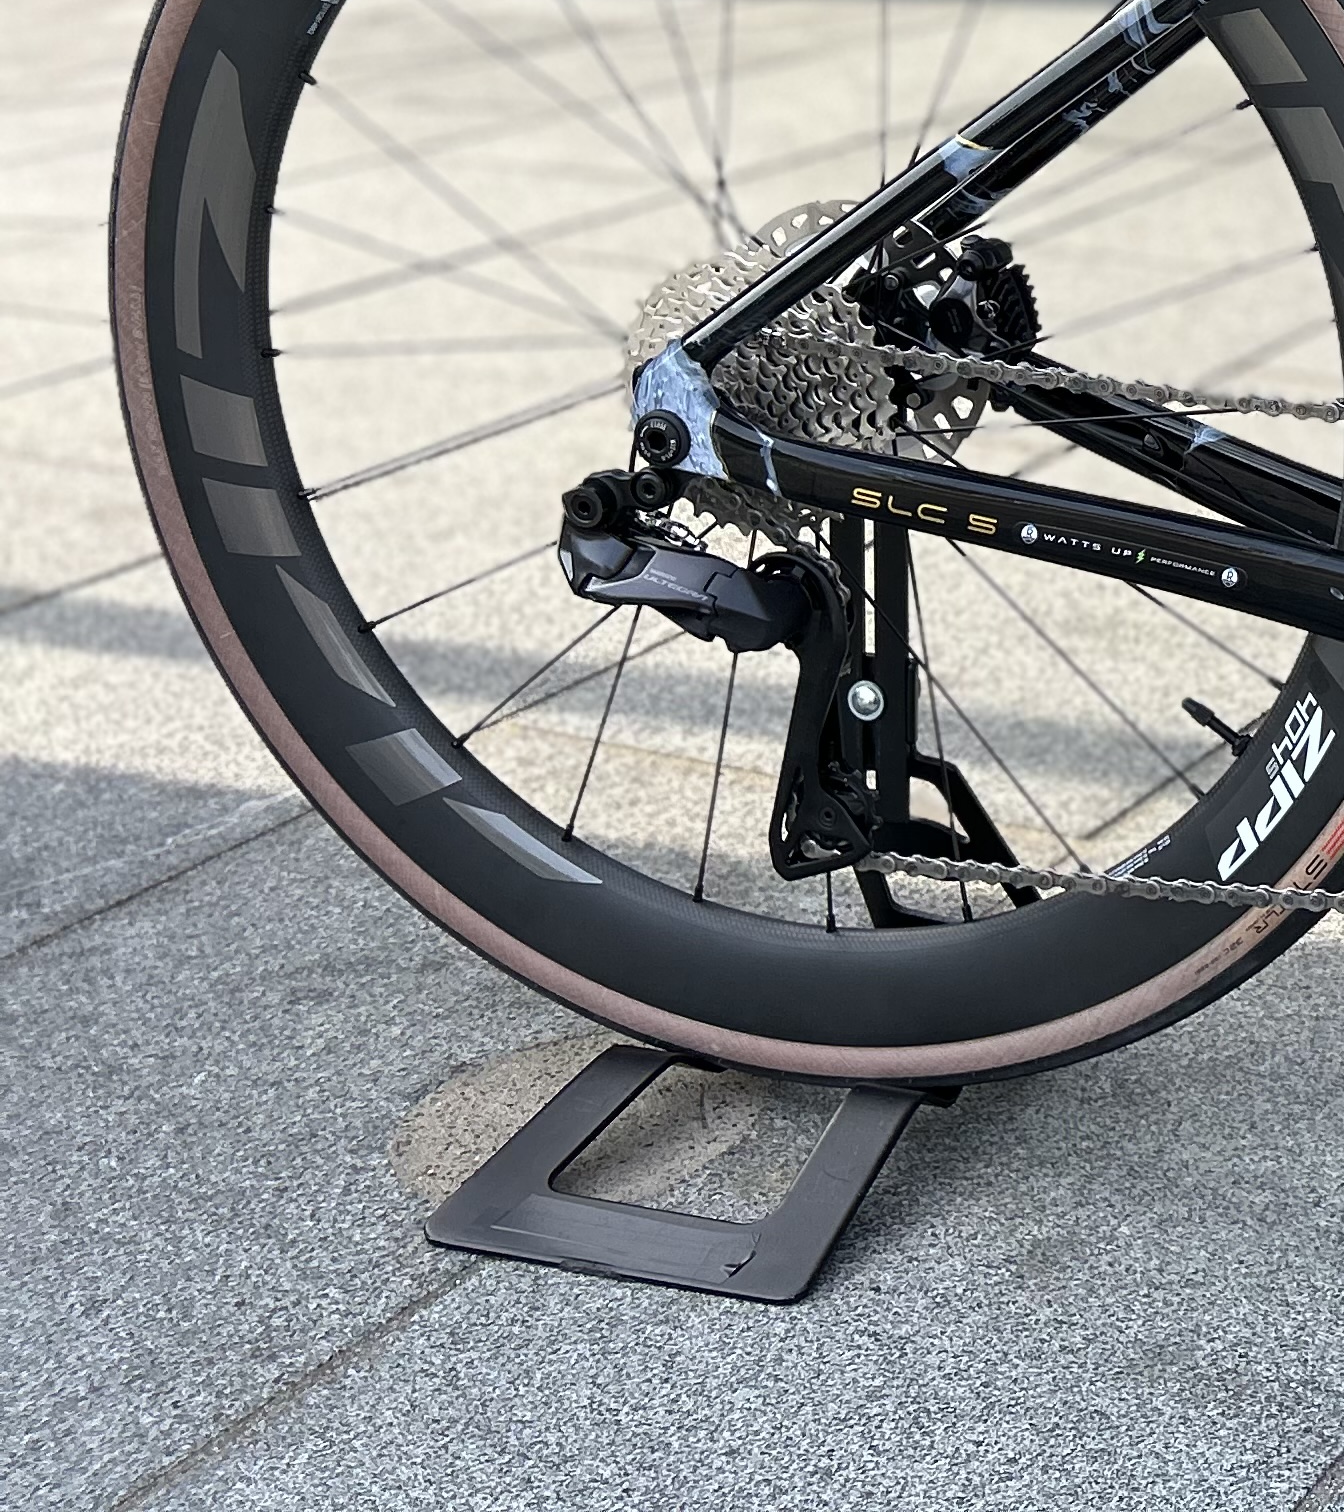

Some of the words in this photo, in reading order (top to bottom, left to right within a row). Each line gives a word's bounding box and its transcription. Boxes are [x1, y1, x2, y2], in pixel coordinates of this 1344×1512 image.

[851, 487, 948, 524] SLC
[1043, 533, 1101, 551] WATTS
[1111, 546, 1132, 557] UP
[1217, 705, 1336, 882] ZIPP
